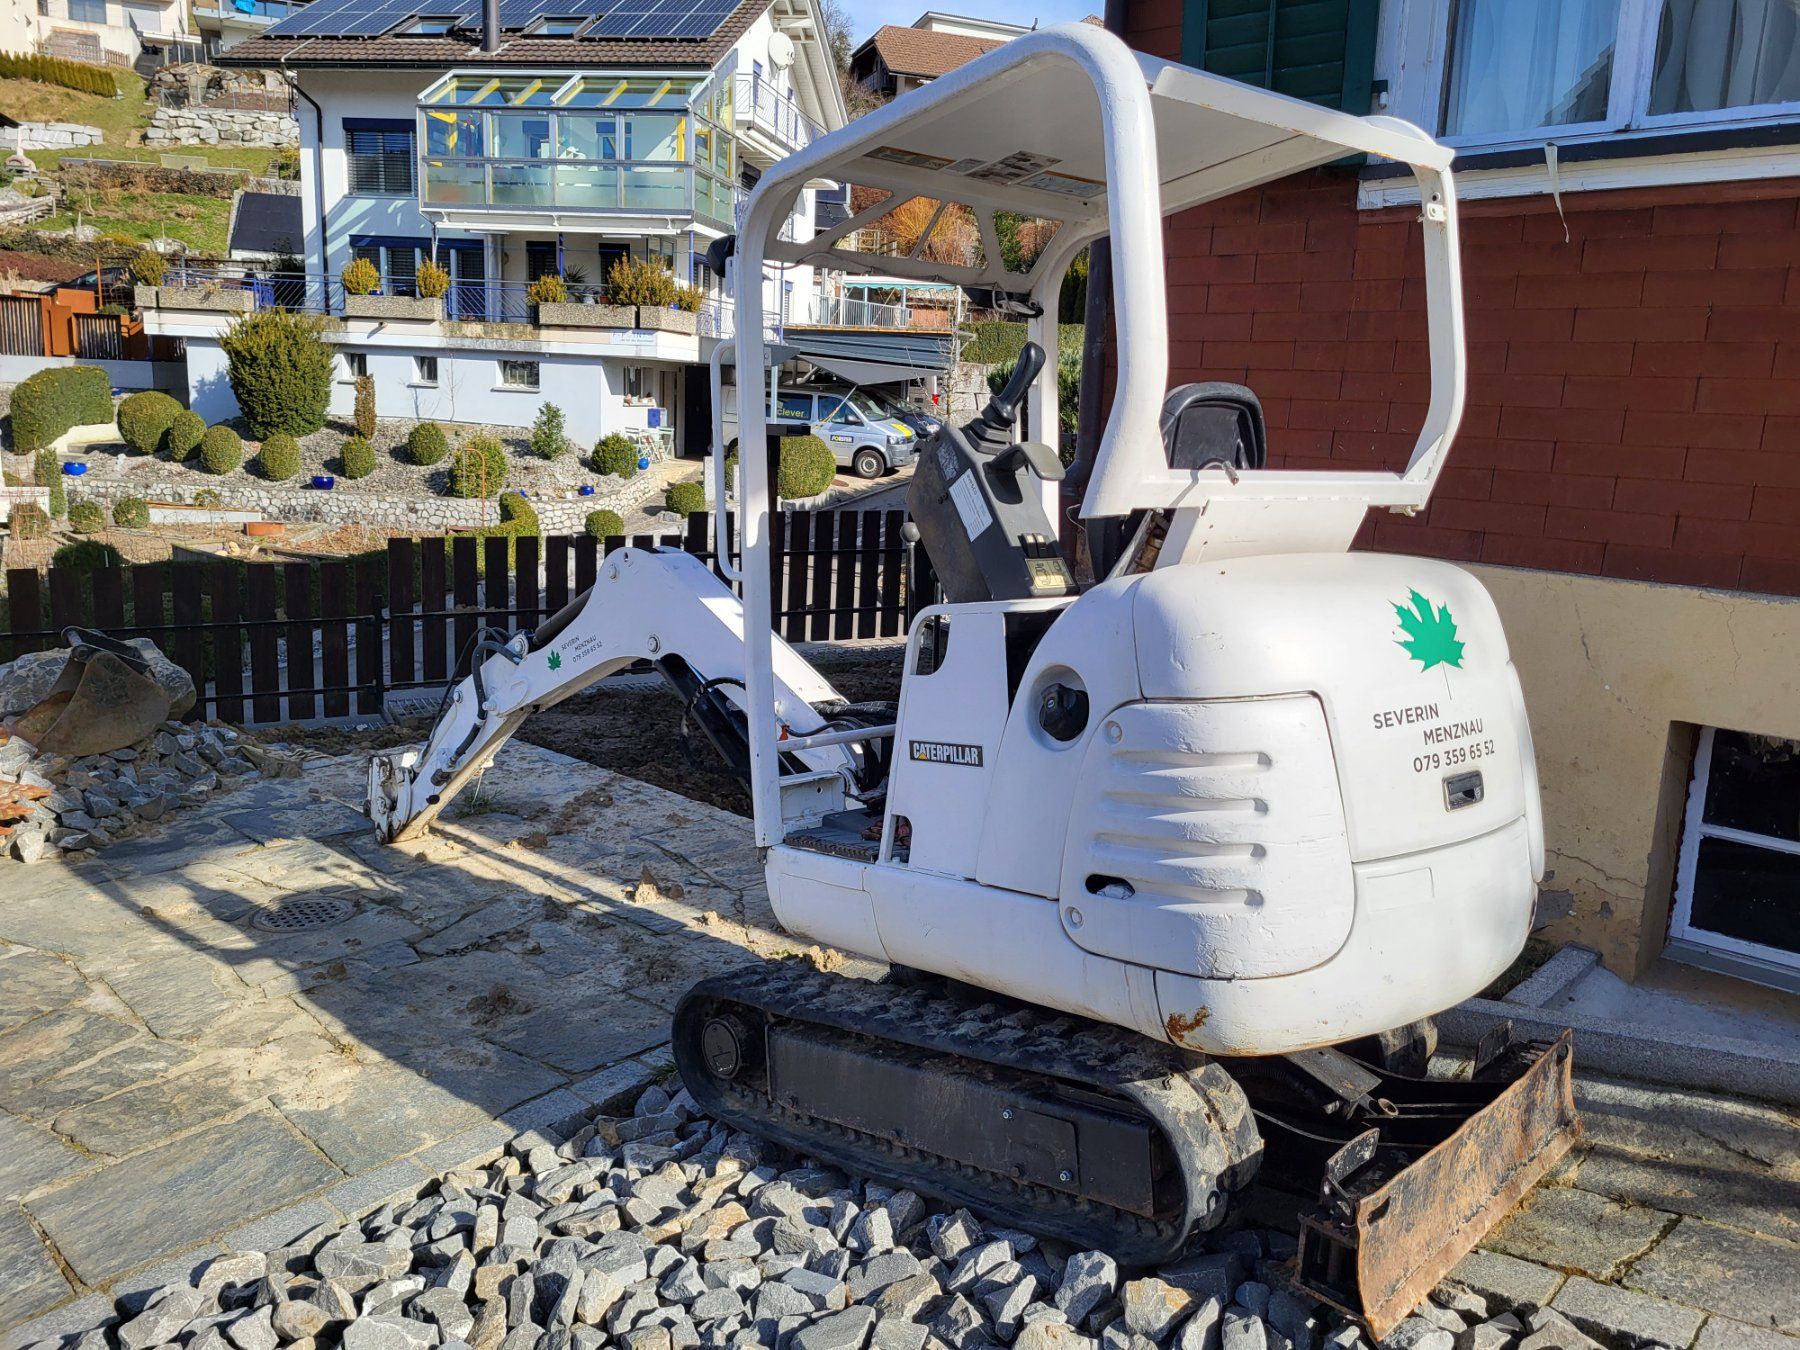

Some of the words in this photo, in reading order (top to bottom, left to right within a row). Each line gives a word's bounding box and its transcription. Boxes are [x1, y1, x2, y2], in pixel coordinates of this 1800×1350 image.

[1373, 703, 1440, 729] SEVERIN
[1423, 718, 1484, 745] MENZNAU
[912, 742, 979, 764] CATERPILLAR
[1413, 753, 1440, 773] 079
[1444, 747, 1466, 767] 359
[1469, 742, 1482, 760] 65
[1484, 739, 1495, 756] 52
